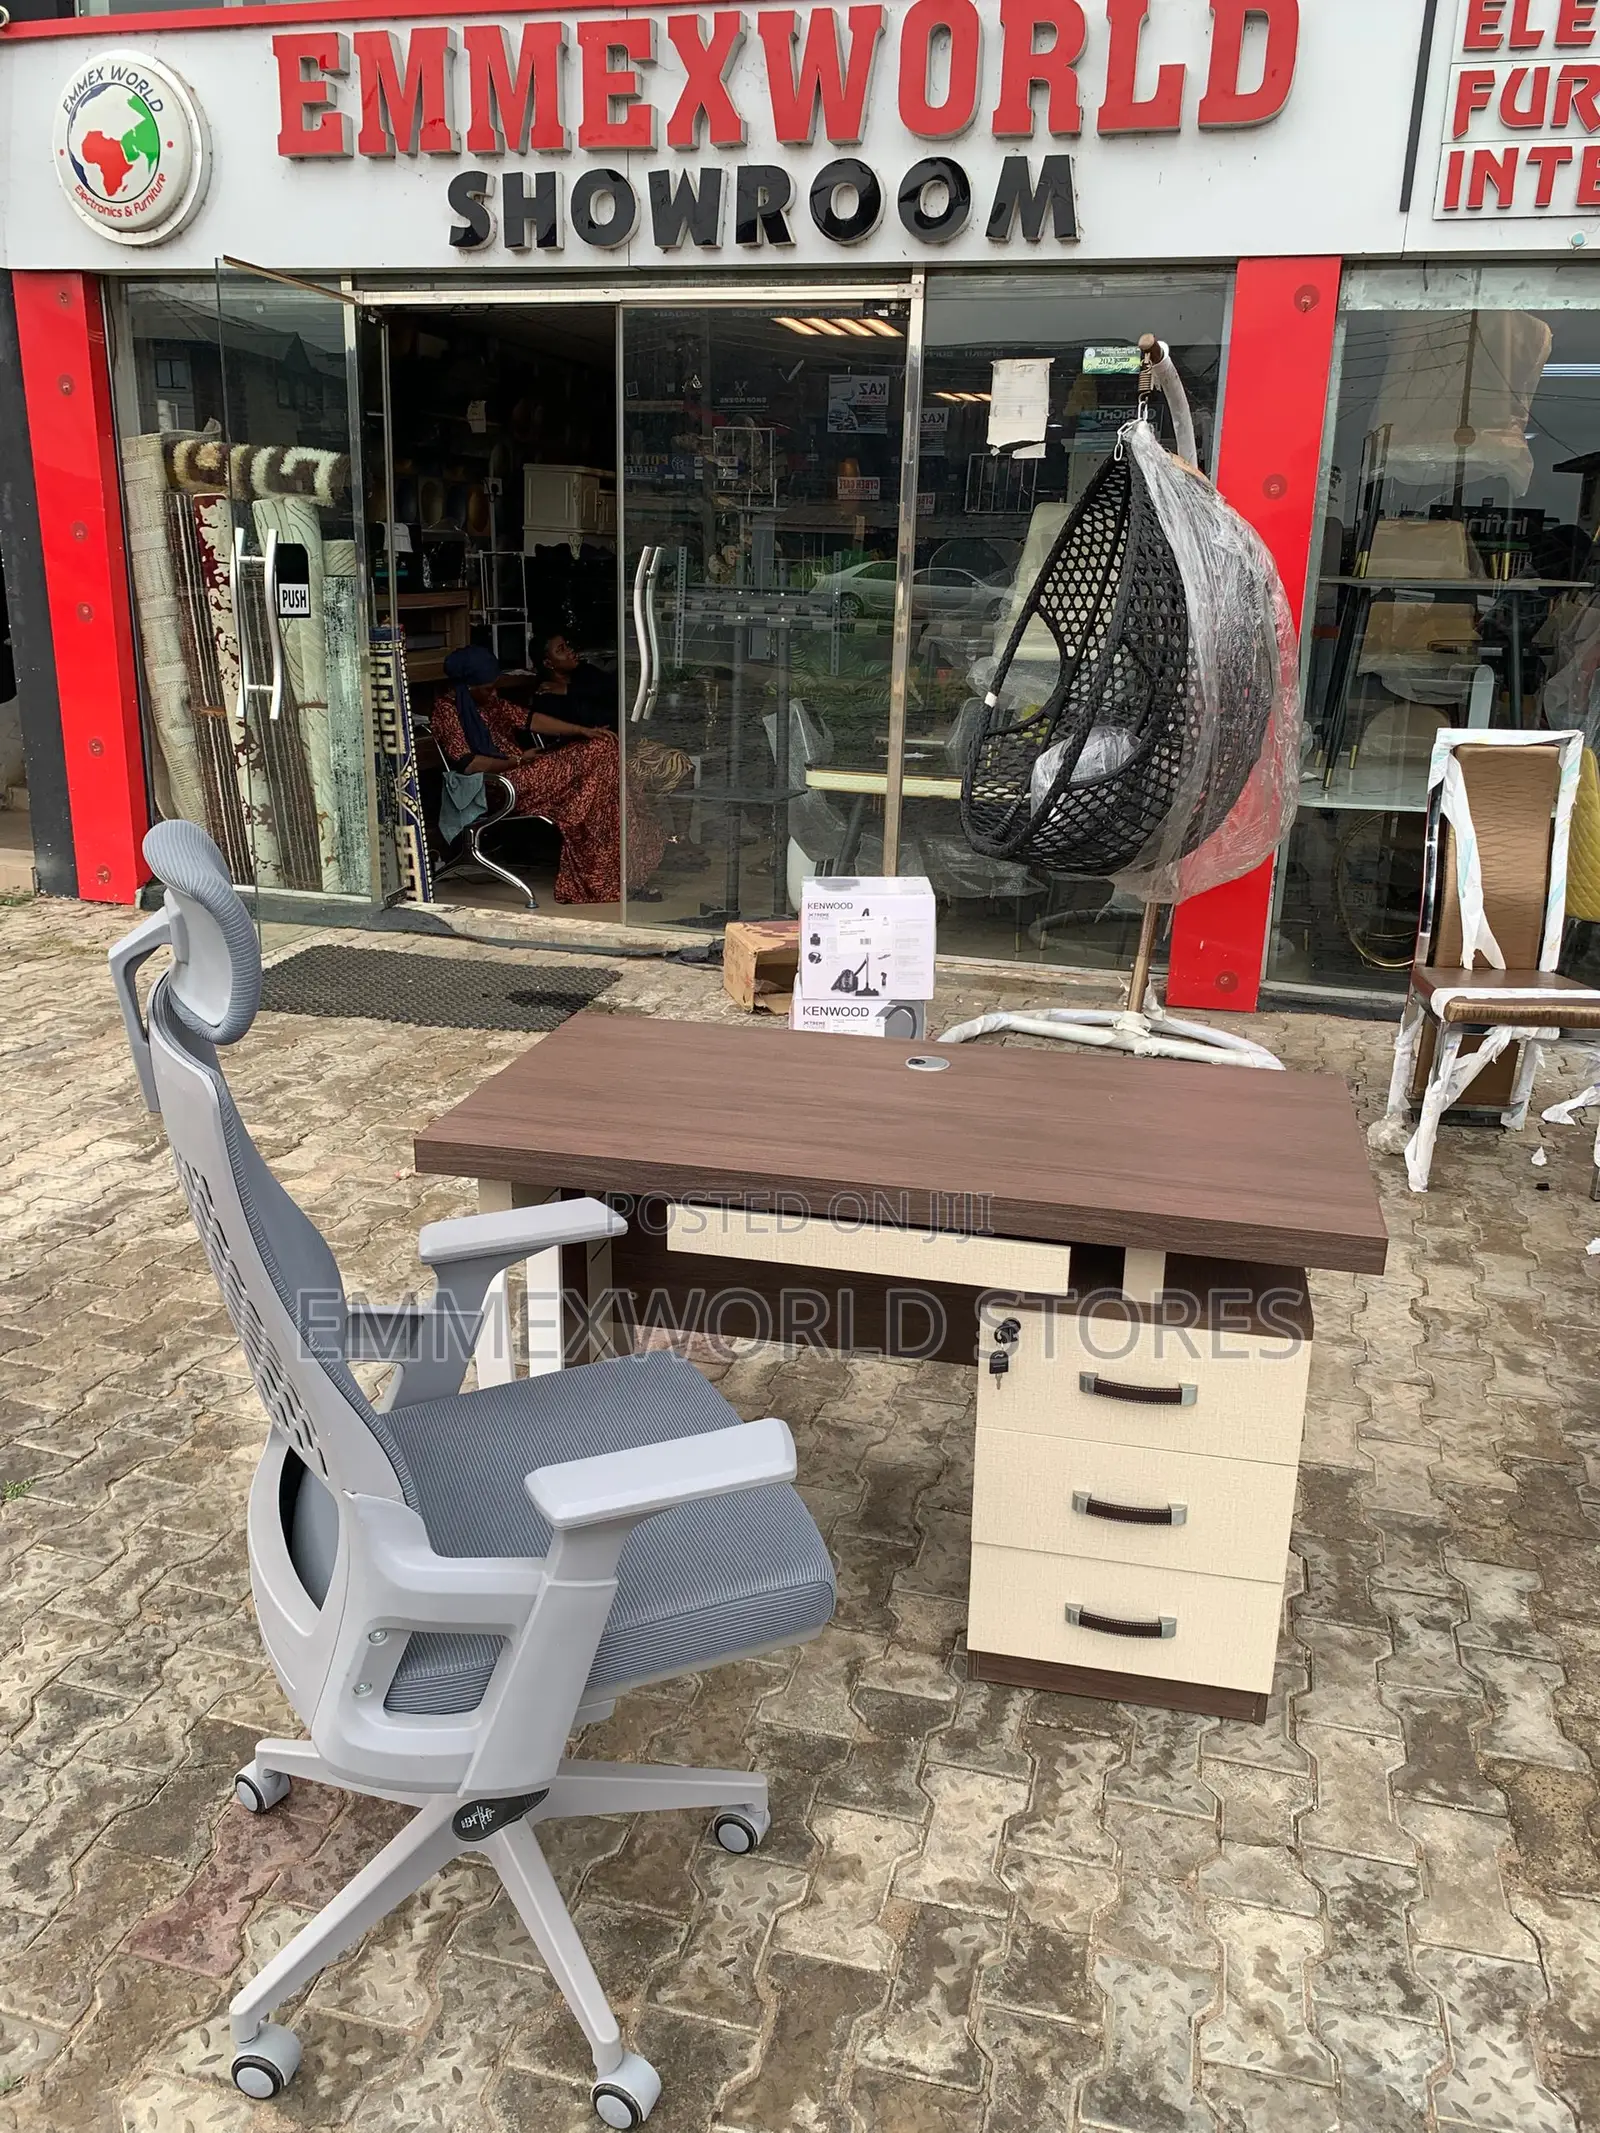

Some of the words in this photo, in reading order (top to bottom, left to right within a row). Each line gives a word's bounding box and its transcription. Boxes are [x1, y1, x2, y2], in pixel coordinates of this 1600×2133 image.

[1463, 0, 1600, 51] ELE
[62, 66, 104, 115] EMMEX
[110, 65, 164, 113] WORLD
[272, 0, 1300, 159] EMMEXWORLD
[1453, 64, 1600, 140] FUR
[74, 184, 123, 218] Electronics
[125, 205, 132, 218] &
[134, 172, 167, 214] Furniture
[448, 154, 1080, 251] SHOWROOM
[282, 589, 307, 608] PUSH
[807, 902, 853, 910] KENWOOD
[803, 1006, 869, 1017] KENWOOD
